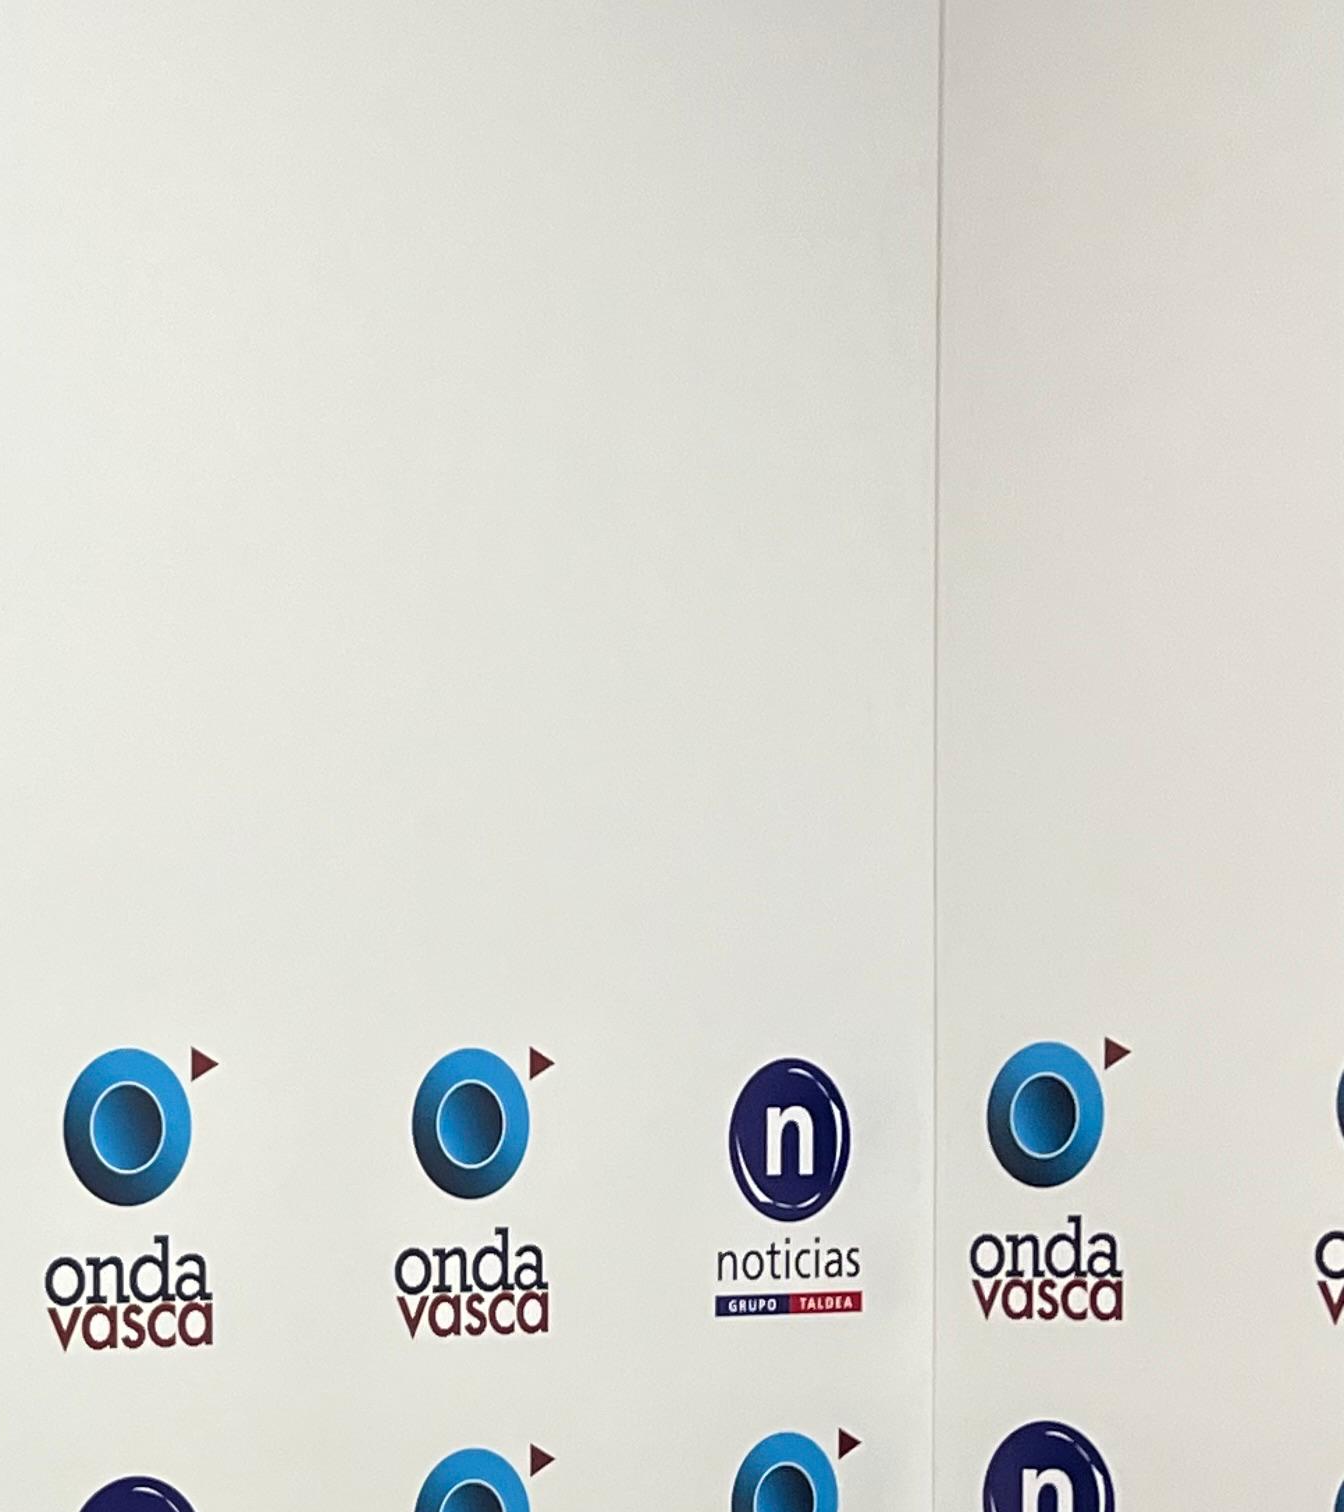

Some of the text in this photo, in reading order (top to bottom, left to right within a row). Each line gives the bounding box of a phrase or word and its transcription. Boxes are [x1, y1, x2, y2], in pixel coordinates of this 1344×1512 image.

[45, 1235, 213, 1305] onda
[394, 1227, 549, 1293] onda
[717, 1237, 860, 1281] noticias
[970, 1215, 1123, 1278] onda
[396, 1290, 549, 1339] vasca
[728, 1295, 853, 1313] GRUPO TALDEA
[972, 1278, 1123, 1320] vasca
[48, 1302, 213, 1352] vasca
